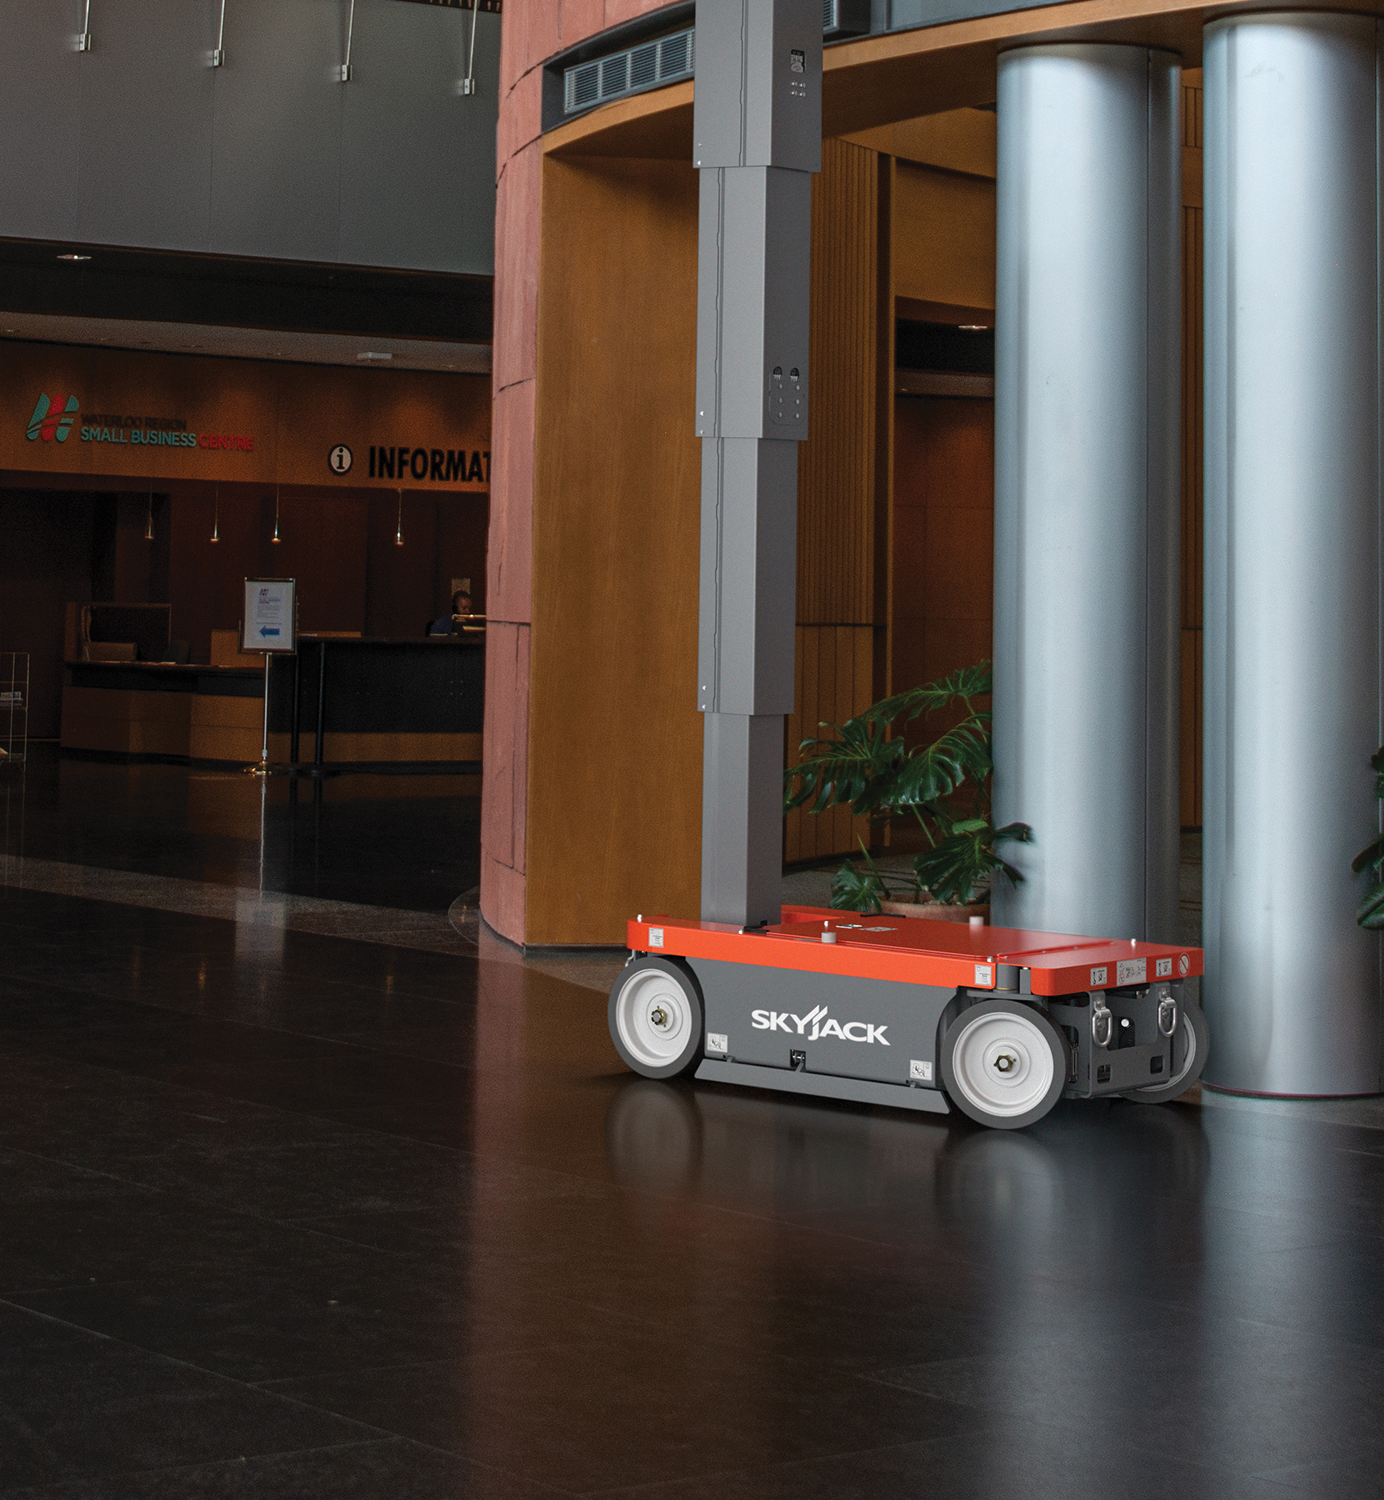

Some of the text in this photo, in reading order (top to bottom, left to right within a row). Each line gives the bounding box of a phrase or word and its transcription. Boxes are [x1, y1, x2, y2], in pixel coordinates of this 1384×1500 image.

[81, 413, 187, 430] WATERLOO REGION
[81, 427, 254, 450] SMALL BUSINESS CENTRE
[751, 1004, 891, 1046] SKYJACK
